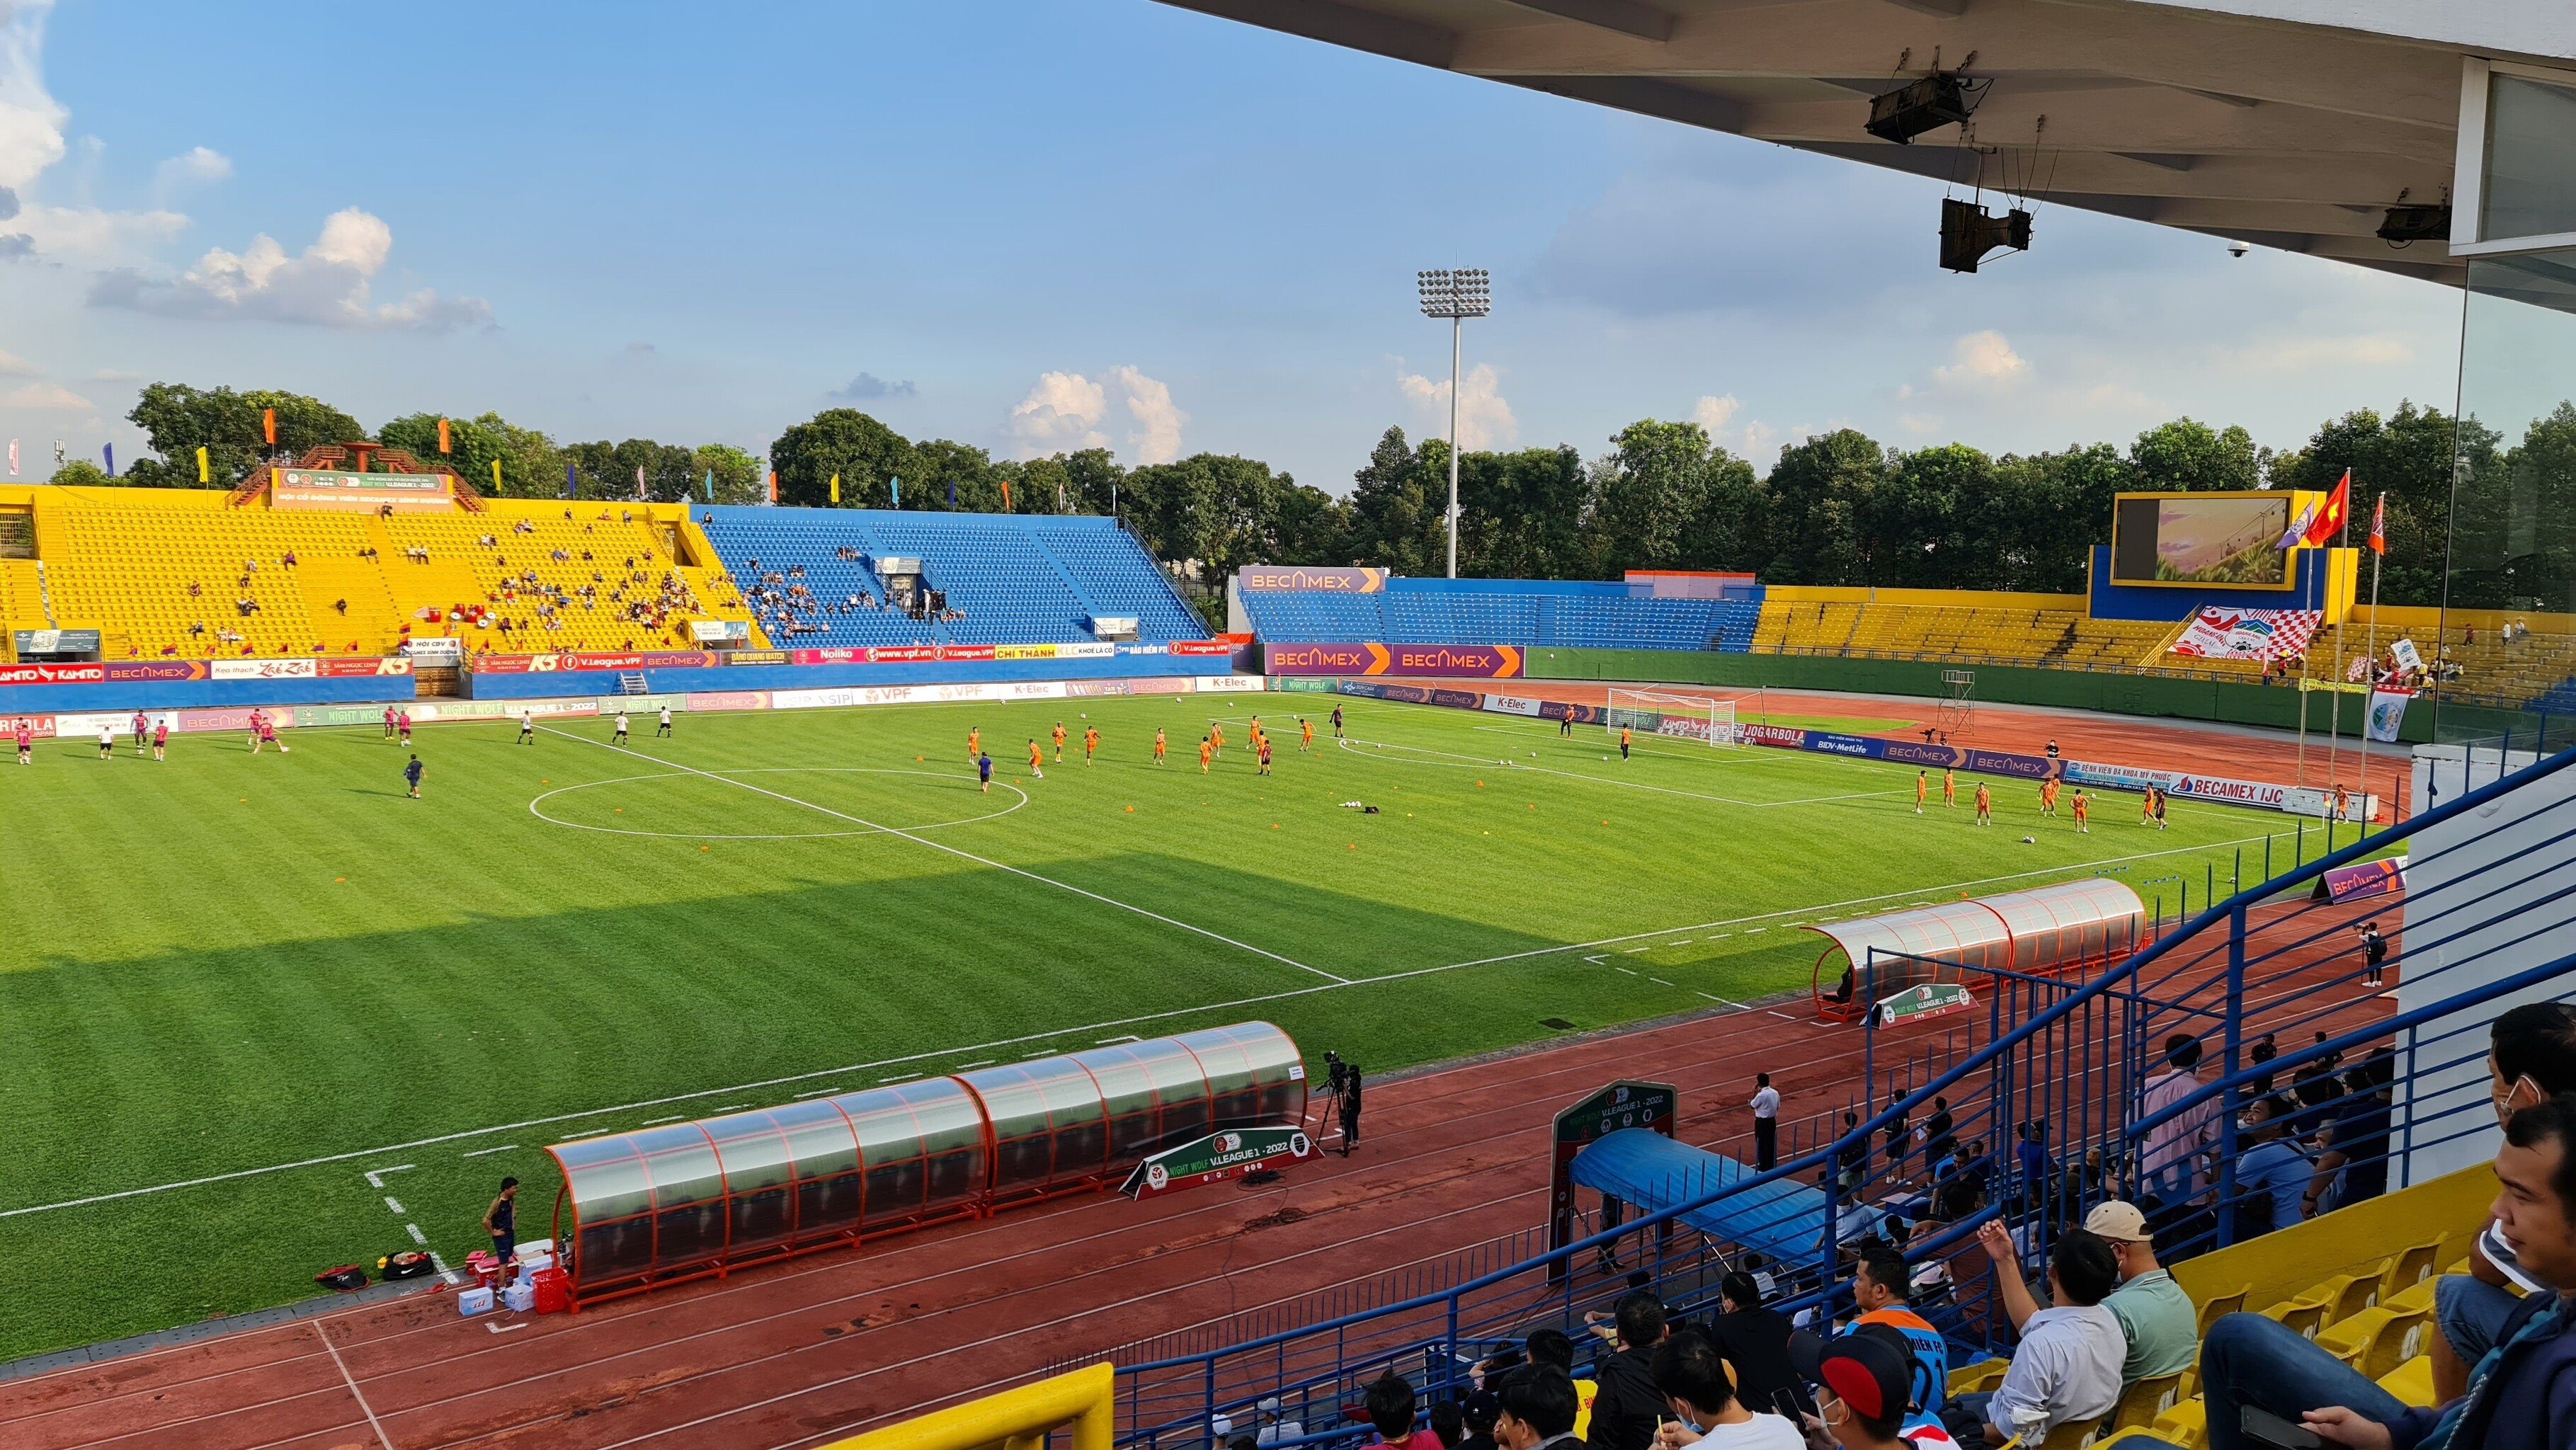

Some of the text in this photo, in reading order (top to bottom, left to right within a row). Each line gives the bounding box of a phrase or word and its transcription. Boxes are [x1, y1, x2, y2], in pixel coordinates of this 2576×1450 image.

[1251, 570, 1351, 588] BECAMEX
[821, 649, 853, 658] Noliko
[878, 649, 931, 660] www.vpf.vn
[947, 649, 994, 658] V.League.VPF
[1275, 647, 1361, 666] BECAMEX
[1402, 649, 1490, 668] BECAMEX
[375, 658, 411, 675] K5
[528, 656, 560, 672] K5
[581, 657, 642, 668] V.League.VPF
[647, 656, 701, 666] BECAMEX
[57, 668, 102, 680] KAMITO
[110, 666, 185, 678] BECAMEX
[955, 685, 984, 697] VPF
[1015, 685, 1049, 694] K-Elec
[1134, 682, 1179, 691] BECAMEX
[882, 687, 911, 700] VPF
[1386, 689, 1420, 700] BECAMEX
[1437, 694, 1473, 705] BECAMEX
[571, 702, 597, 711] 2022
[693, 696, 752, 707] BECAMEX
[1498, 697, 1526, 709] K-Elec
[1543, 706, 1583, 718] BECAEX
[1745, 725, 1805, 742] JOGARBOLA
[1888, 747, 1949, 762] BECAMEX
[1978, 758, 2041, 773] BECAMEX
[2194, 779, 2284, 804] BECAMEX IJC
[1646, 1095, 1664, 1105] 2022
[1169, 1163, 1188, 1176] NIGHT
[1190, 1159, 1209, 1172] WOLF
[1266, 1142, 1289, 1155] 2022
